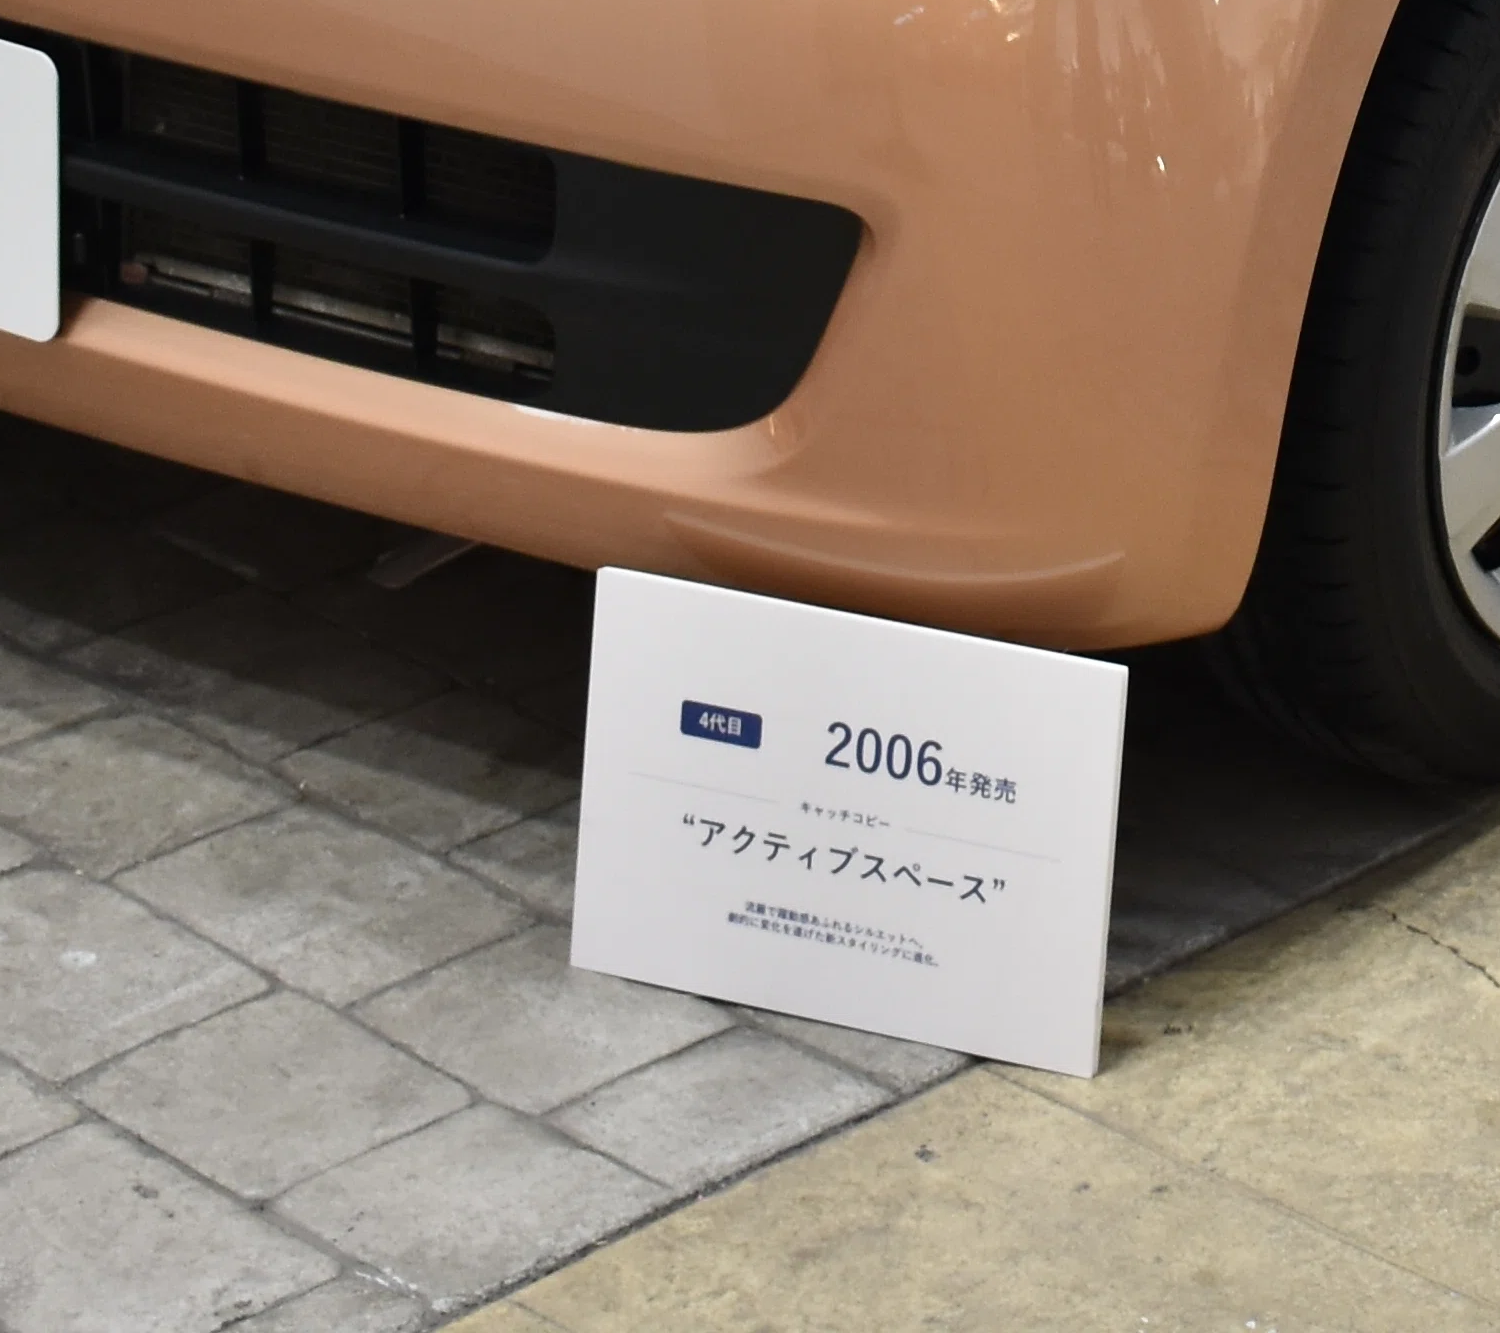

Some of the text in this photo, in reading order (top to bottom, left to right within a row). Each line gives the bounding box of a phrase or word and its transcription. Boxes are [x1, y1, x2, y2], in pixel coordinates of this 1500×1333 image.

[698, 710, 743, 737] 4代目
[824, 721, 1018, 804] 2006年発売
[799, 801, 891, 829] キャッチコピー
